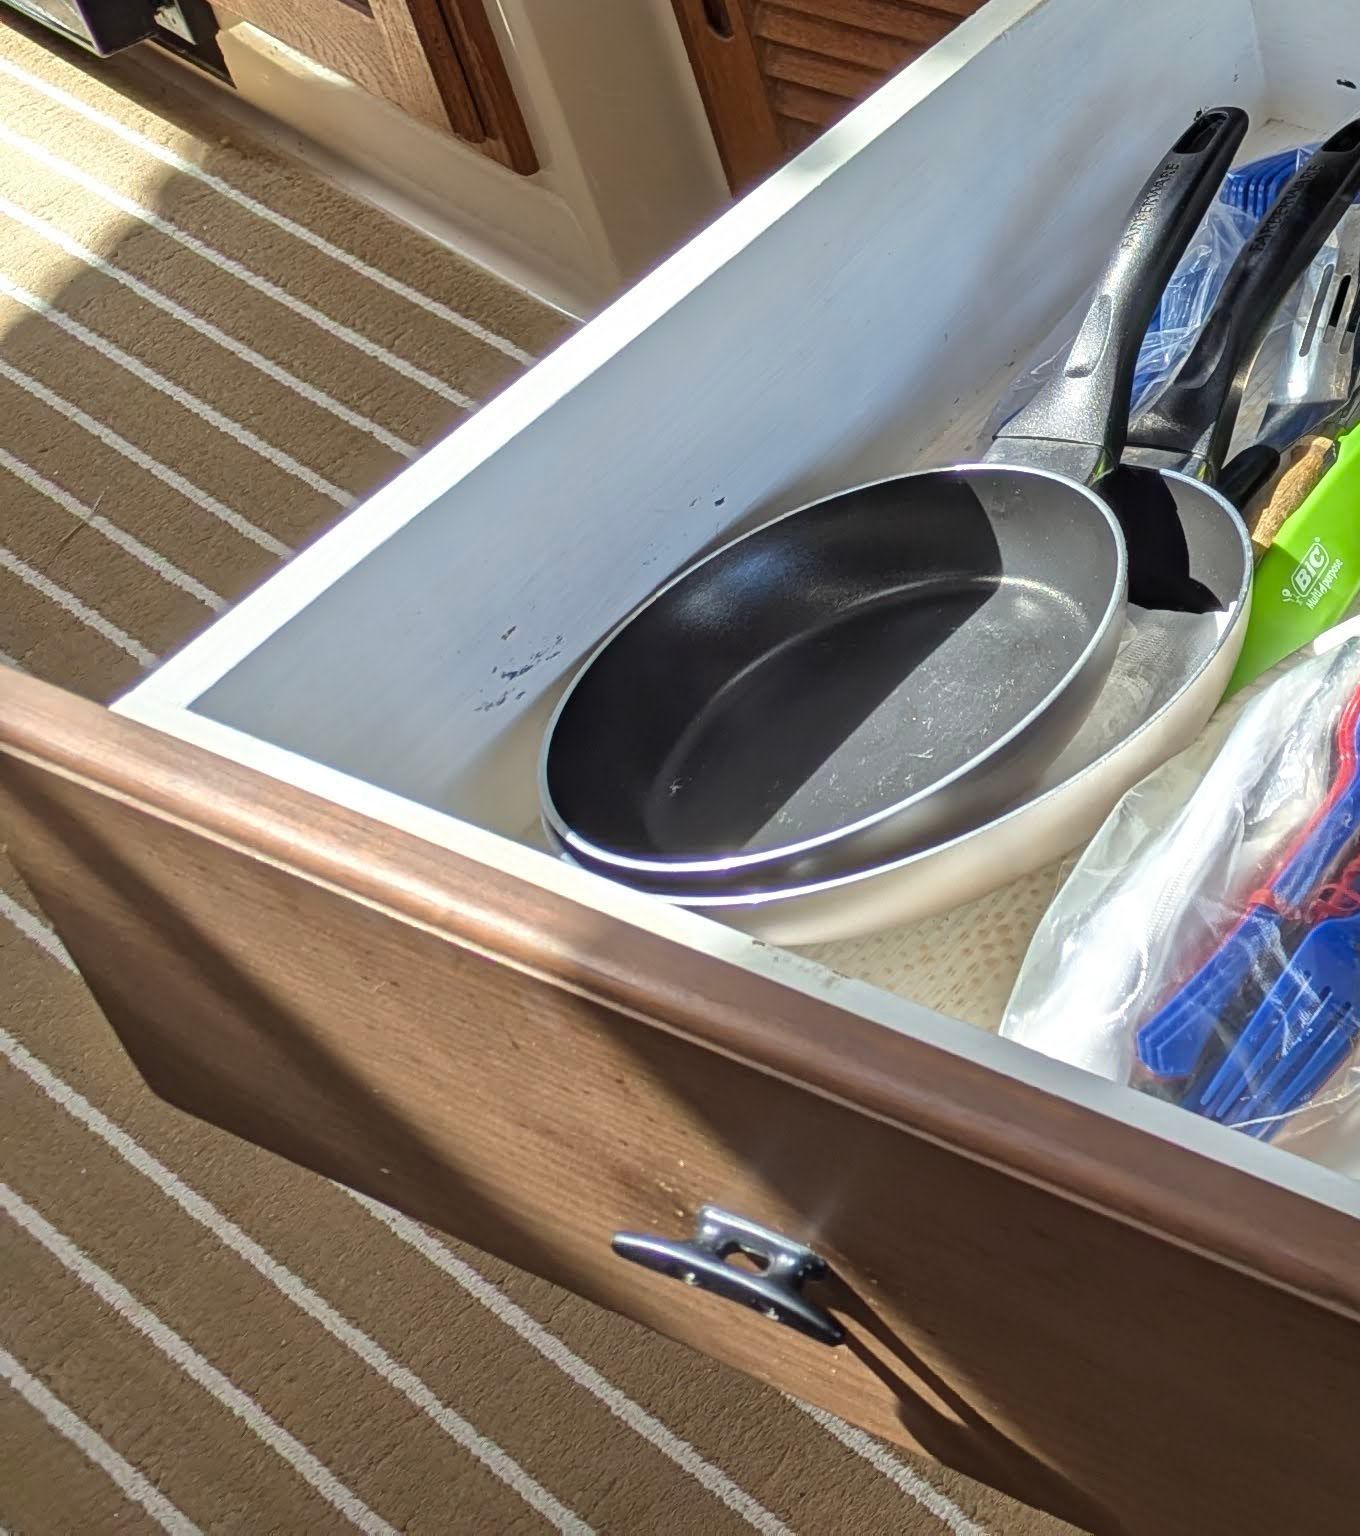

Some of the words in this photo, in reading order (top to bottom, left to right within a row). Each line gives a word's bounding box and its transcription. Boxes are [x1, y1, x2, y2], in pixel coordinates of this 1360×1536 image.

[1295, 546, 1325, 591] BIC
[1306, 588, 1322, 609] Multi
[1322, 559, 1344, 590] purpose
